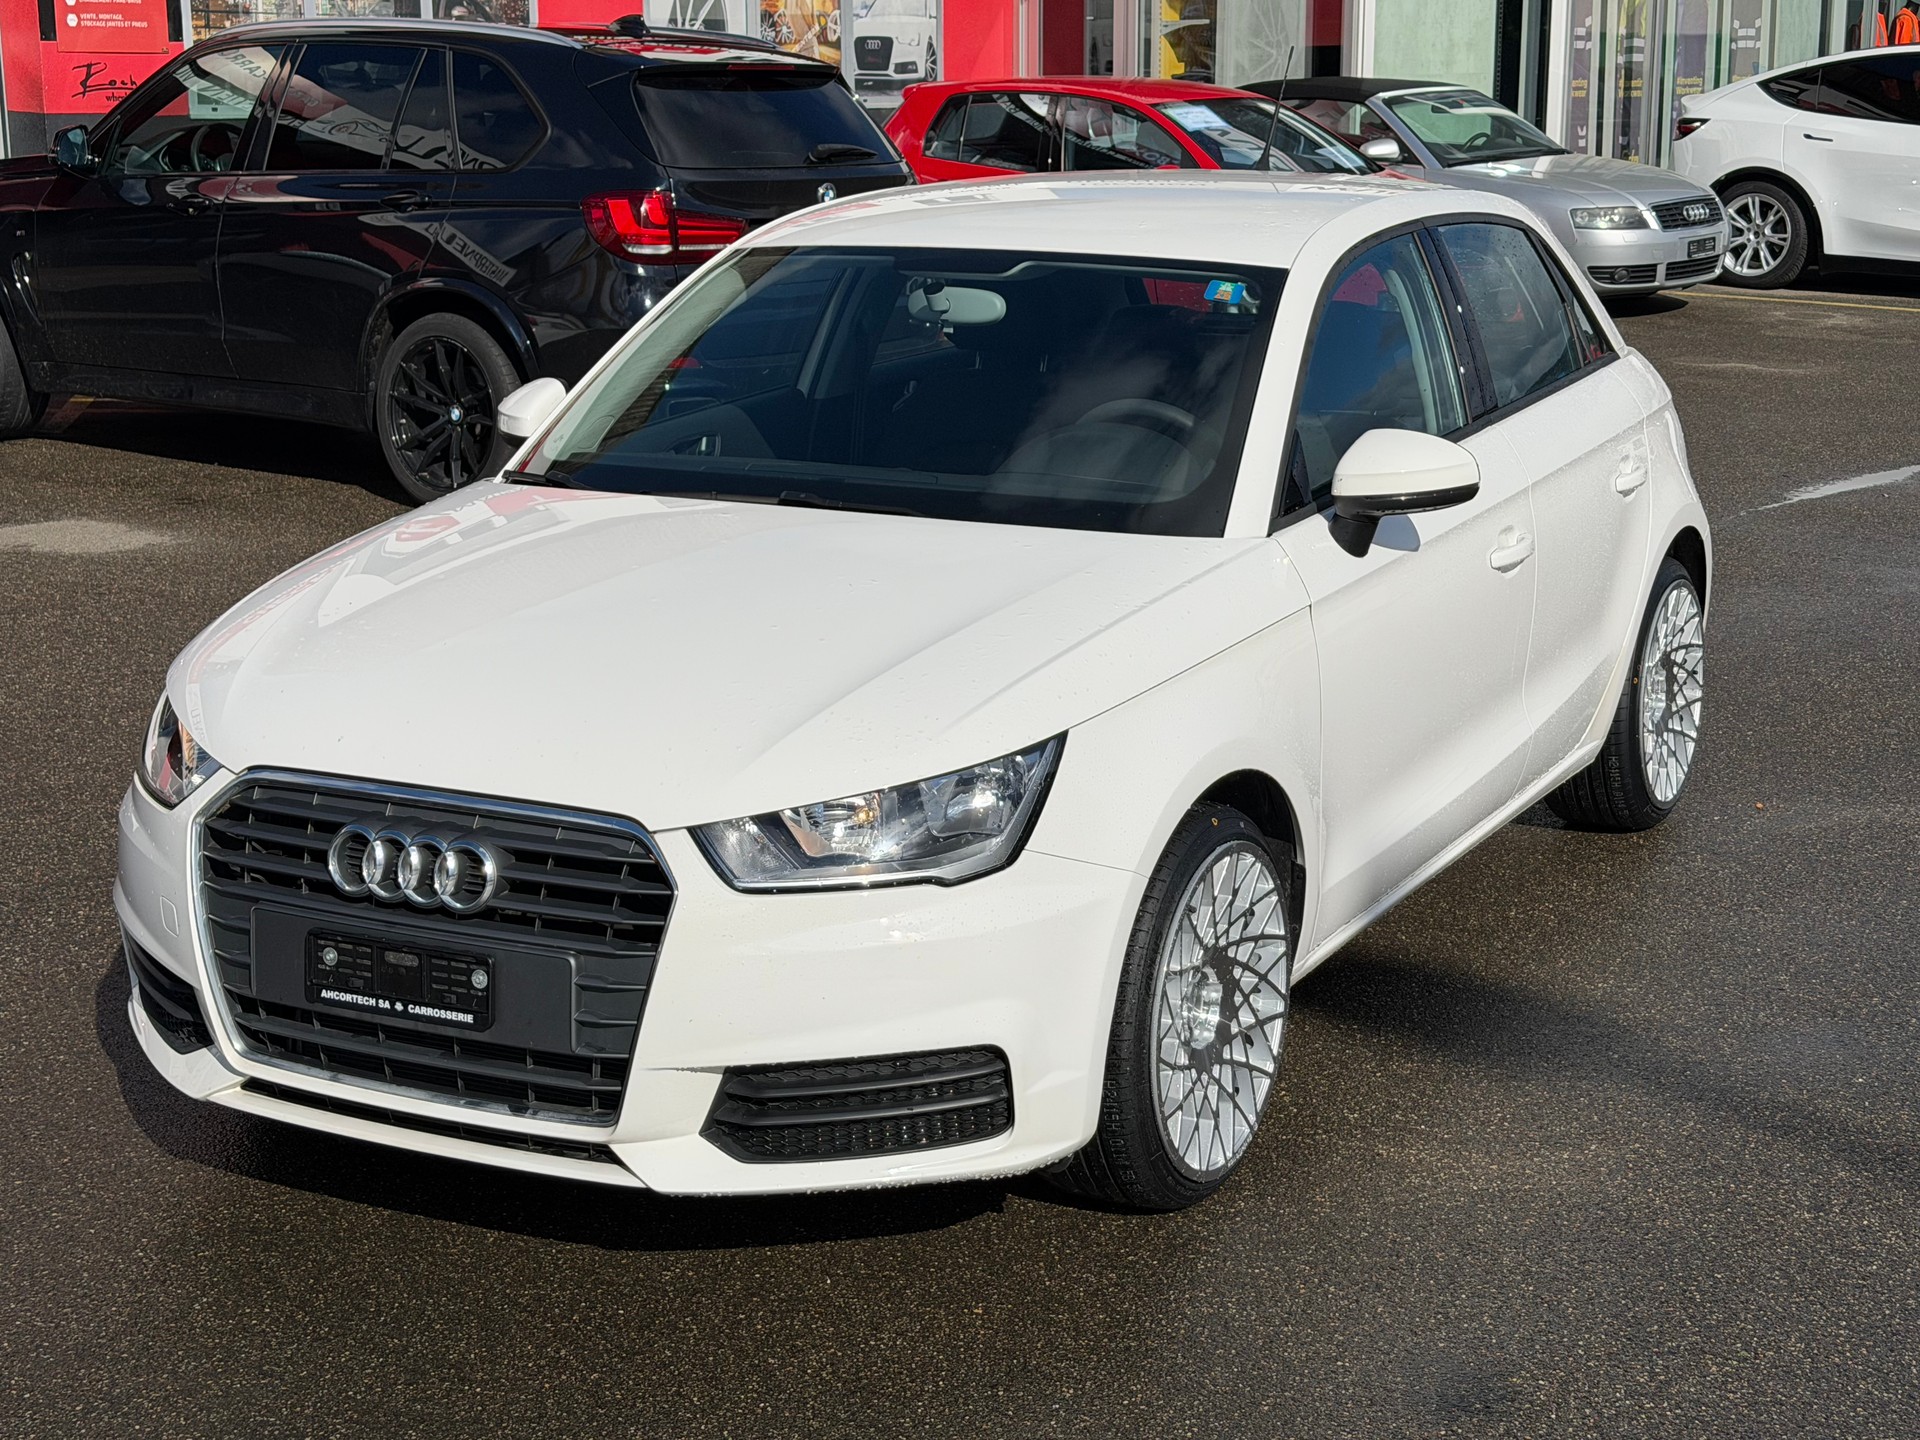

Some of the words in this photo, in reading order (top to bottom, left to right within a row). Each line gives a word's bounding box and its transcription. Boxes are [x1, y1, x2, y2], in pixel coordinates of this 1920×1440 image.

[320, 989, 376, 1007] AHCORTECH
[378, 999, 391, 1010] SA
[407, 1004, 475, 1024] CARROSSERIE
